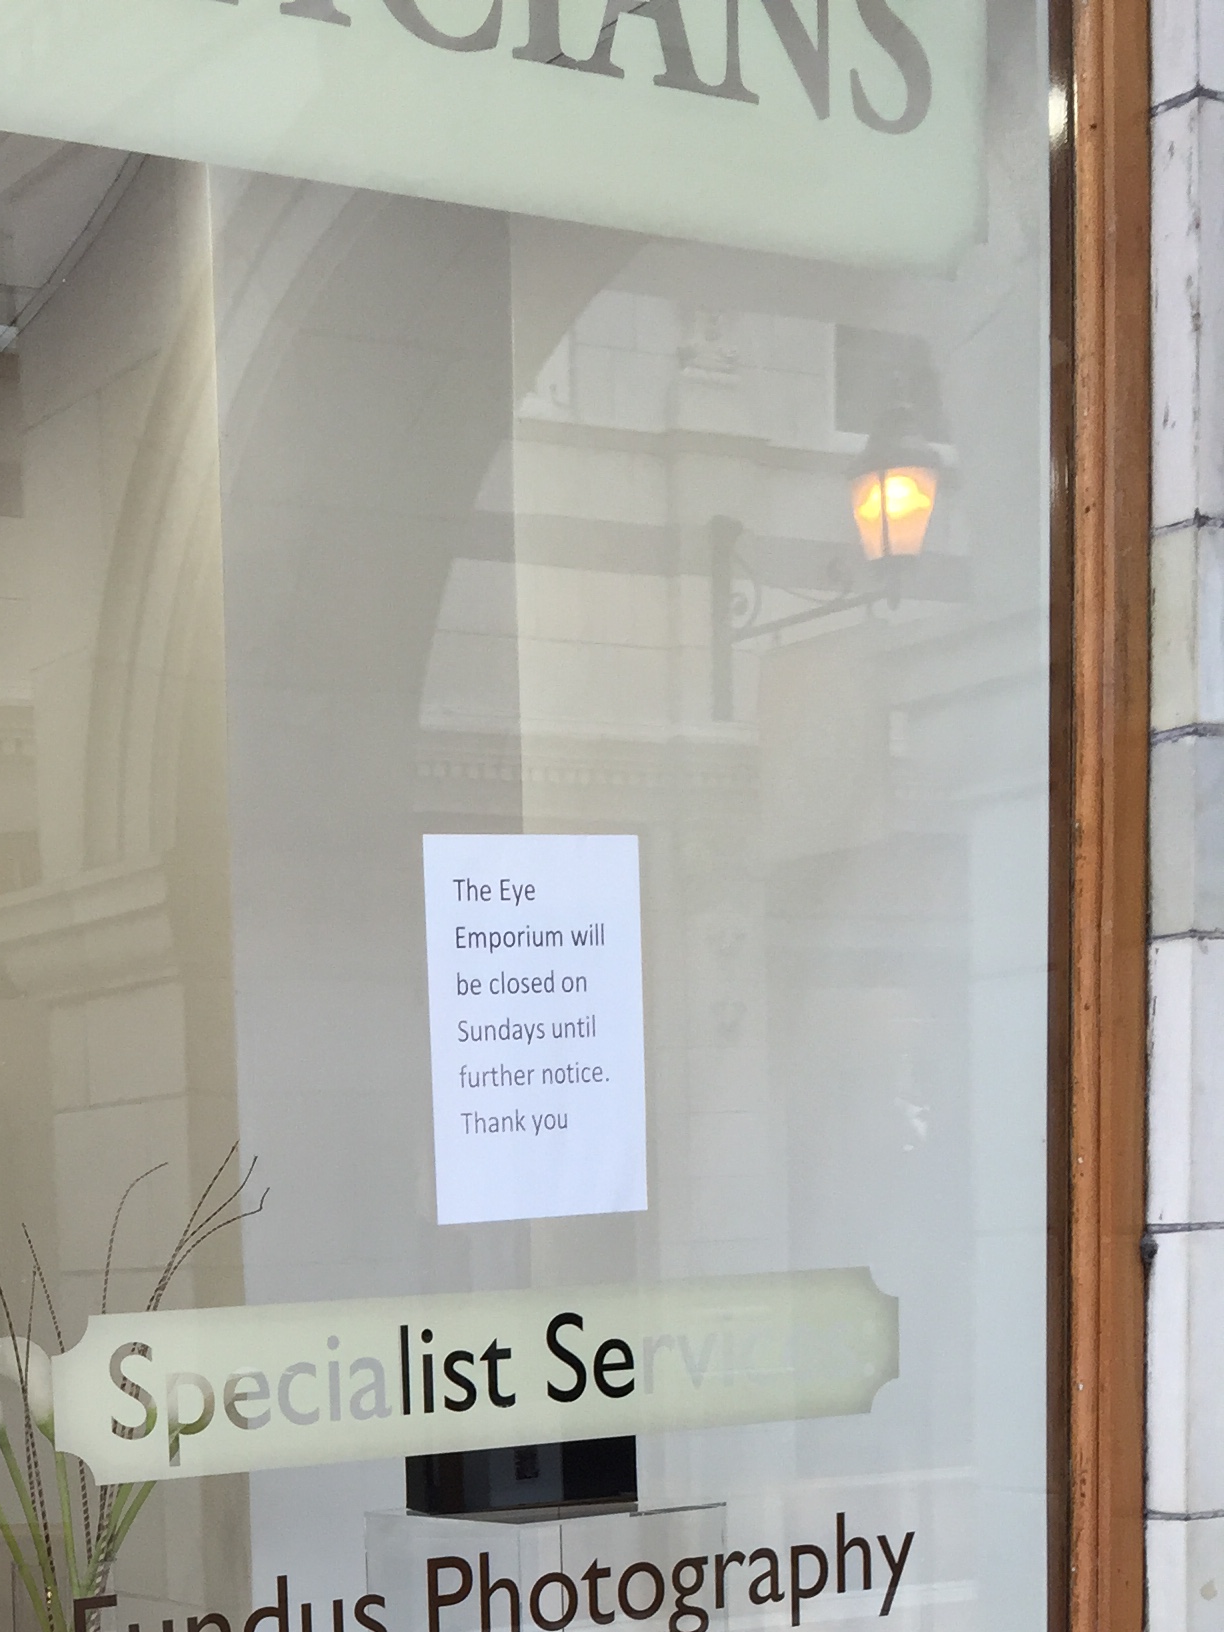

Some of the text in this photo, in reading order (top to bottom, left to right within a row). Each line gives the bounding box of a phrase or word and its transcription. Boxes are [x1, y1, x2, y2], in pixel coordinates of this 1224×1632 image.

[453, 878, 536, 906] The Eye
[455, 923, 606, 953] Emporium will
[456, 970, 588, 997] be closed on
[457, 1015, 597, 1046] Sundays until
[459, 1062, 610, 1089] further notice.
[461, 1109, 569, 1137] Thank you
[108, 1323, 516, 1468] Specialist
